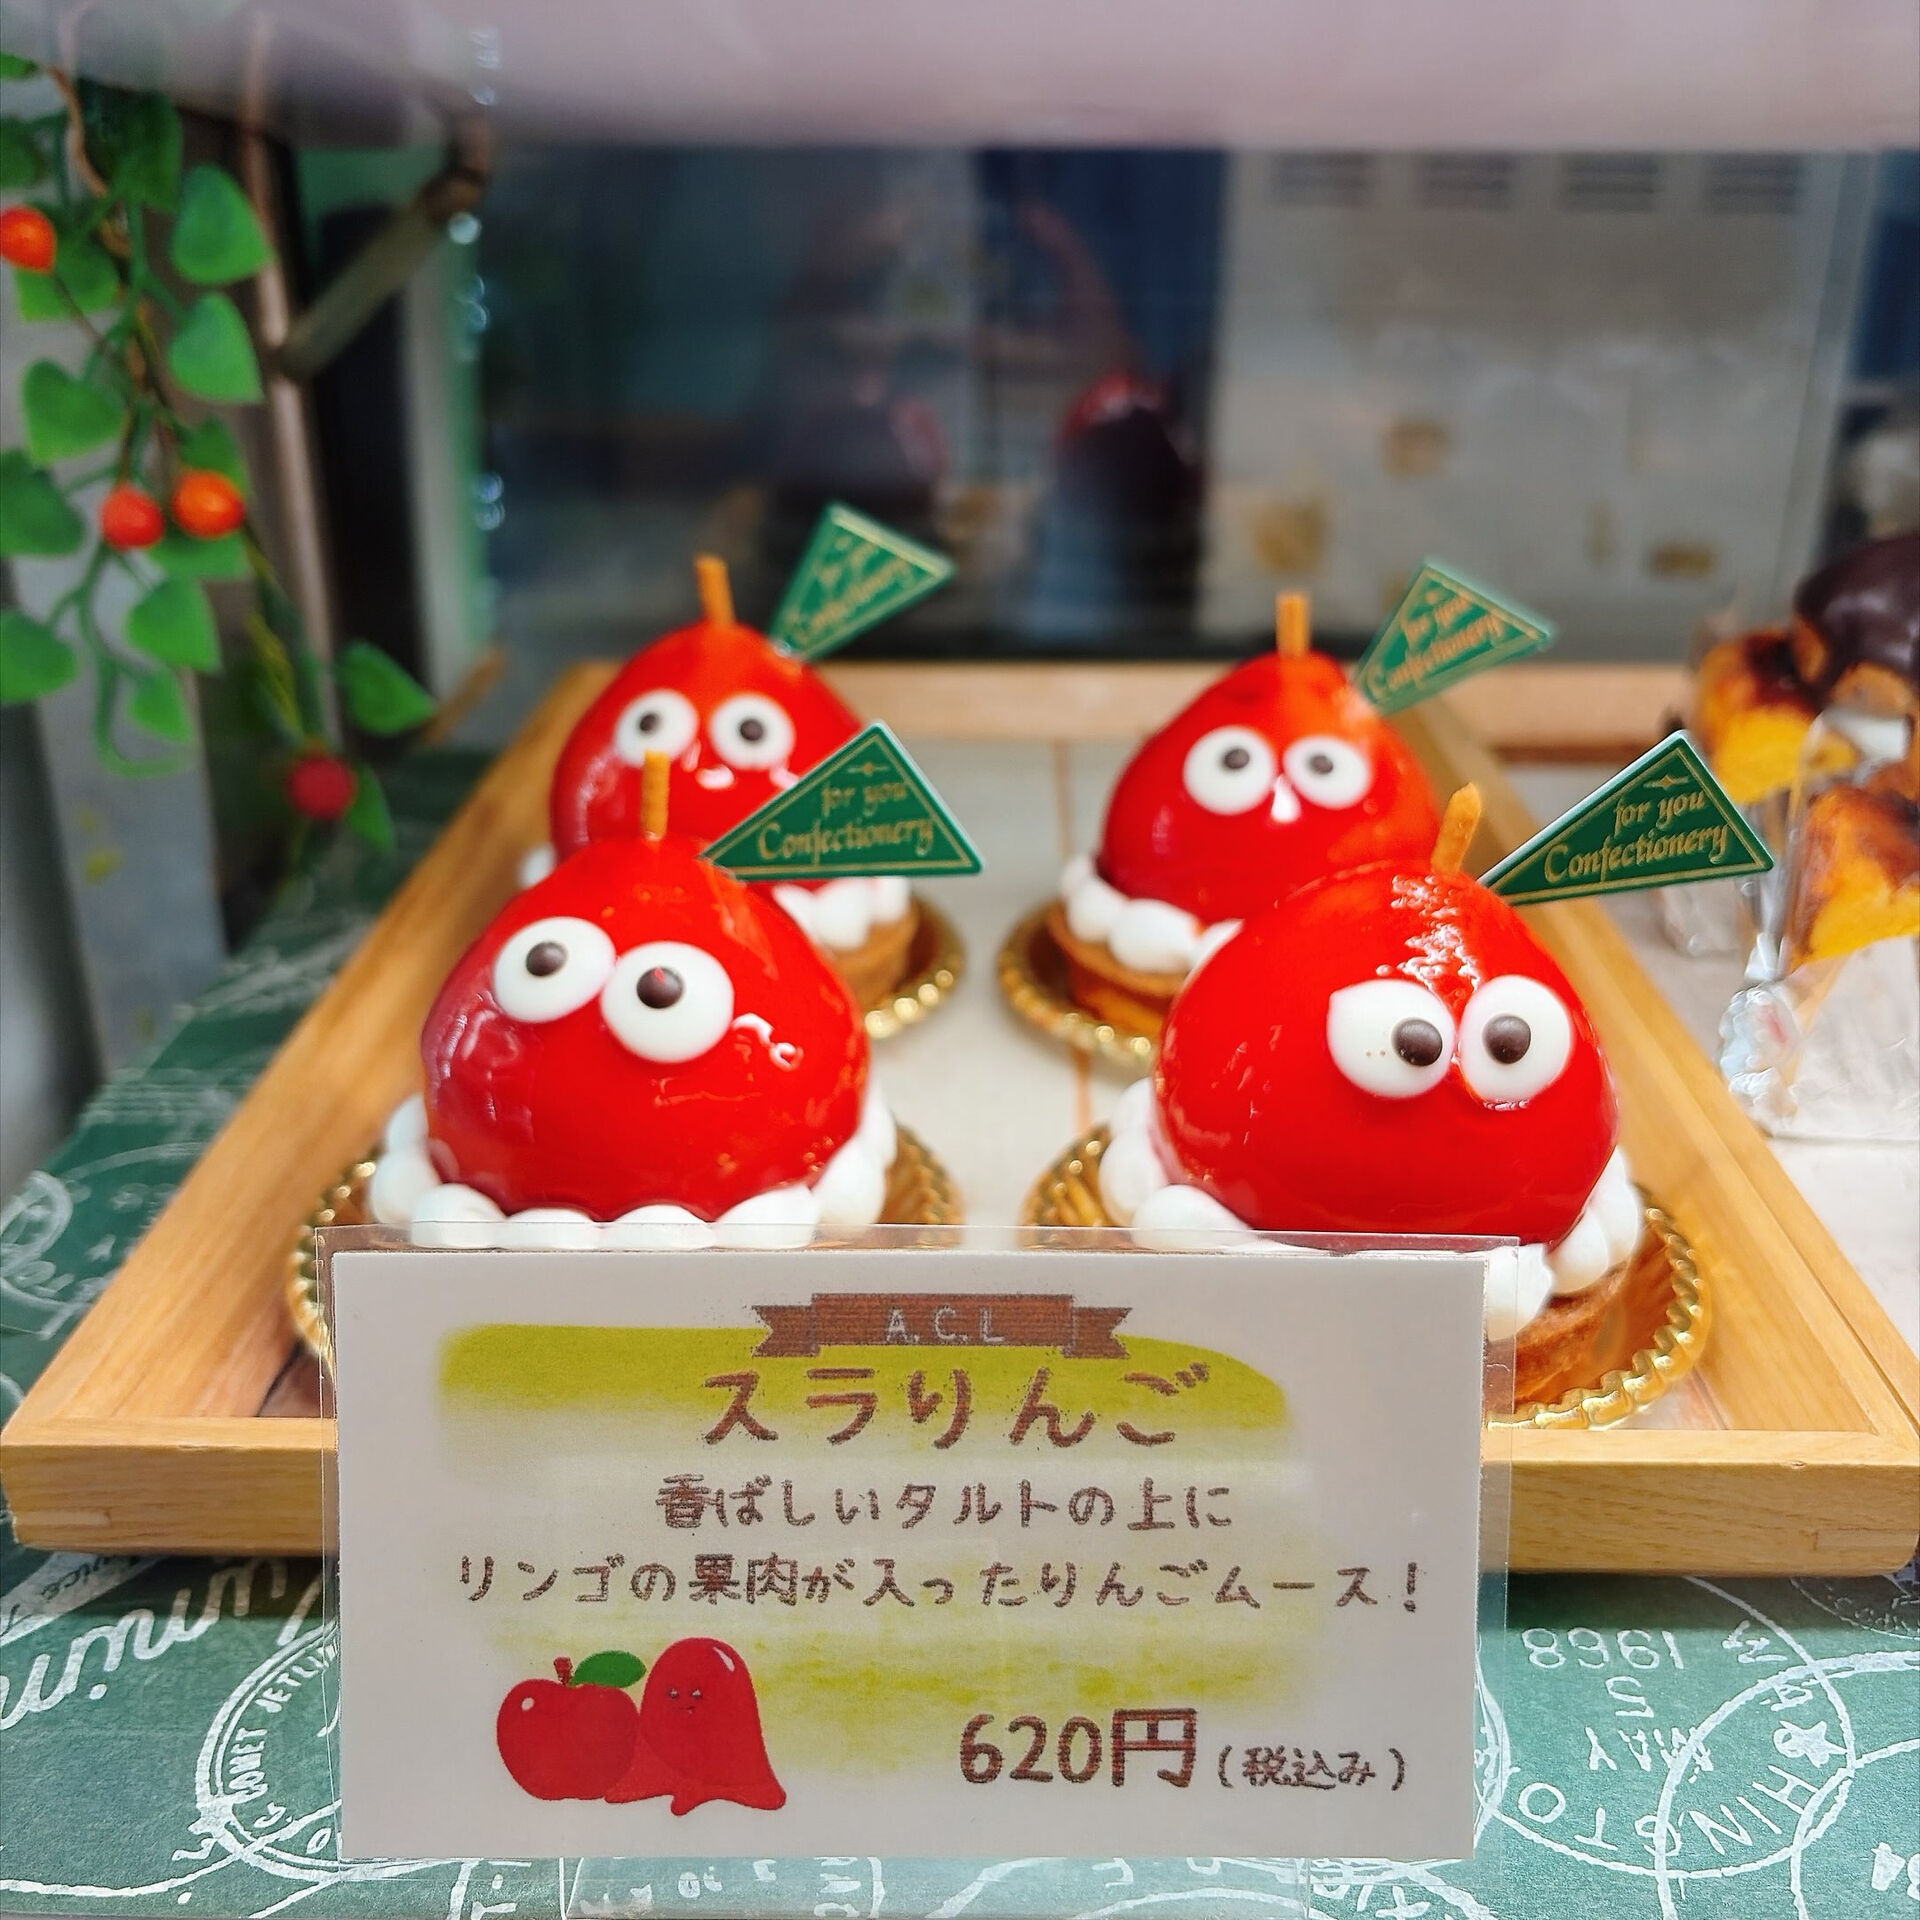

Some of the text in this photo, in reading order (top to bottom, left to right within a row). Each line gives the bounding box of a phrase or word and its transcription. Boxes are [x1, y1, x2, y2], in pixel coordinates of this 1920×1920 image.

[822, 780, 907, 817] for you
[1614, 791, 1706, 838] for you
[757, 819, 933, 866] Confectionery
[1543, 822, 1731, 883] Confectionery
[703, 1362, 1211, 1449] スラりんご
[655, 1474, 1233, 1531] 香ばしいタルトの上に
[460, 1551, 1418, 1613] リンゴの果肉が入ったりんごムース！
[1521, 1626, 1685, 1669] 1968
[1605, 1676, 1655, 1718] 5
[959, 1708, 1198, 1787] 620円
